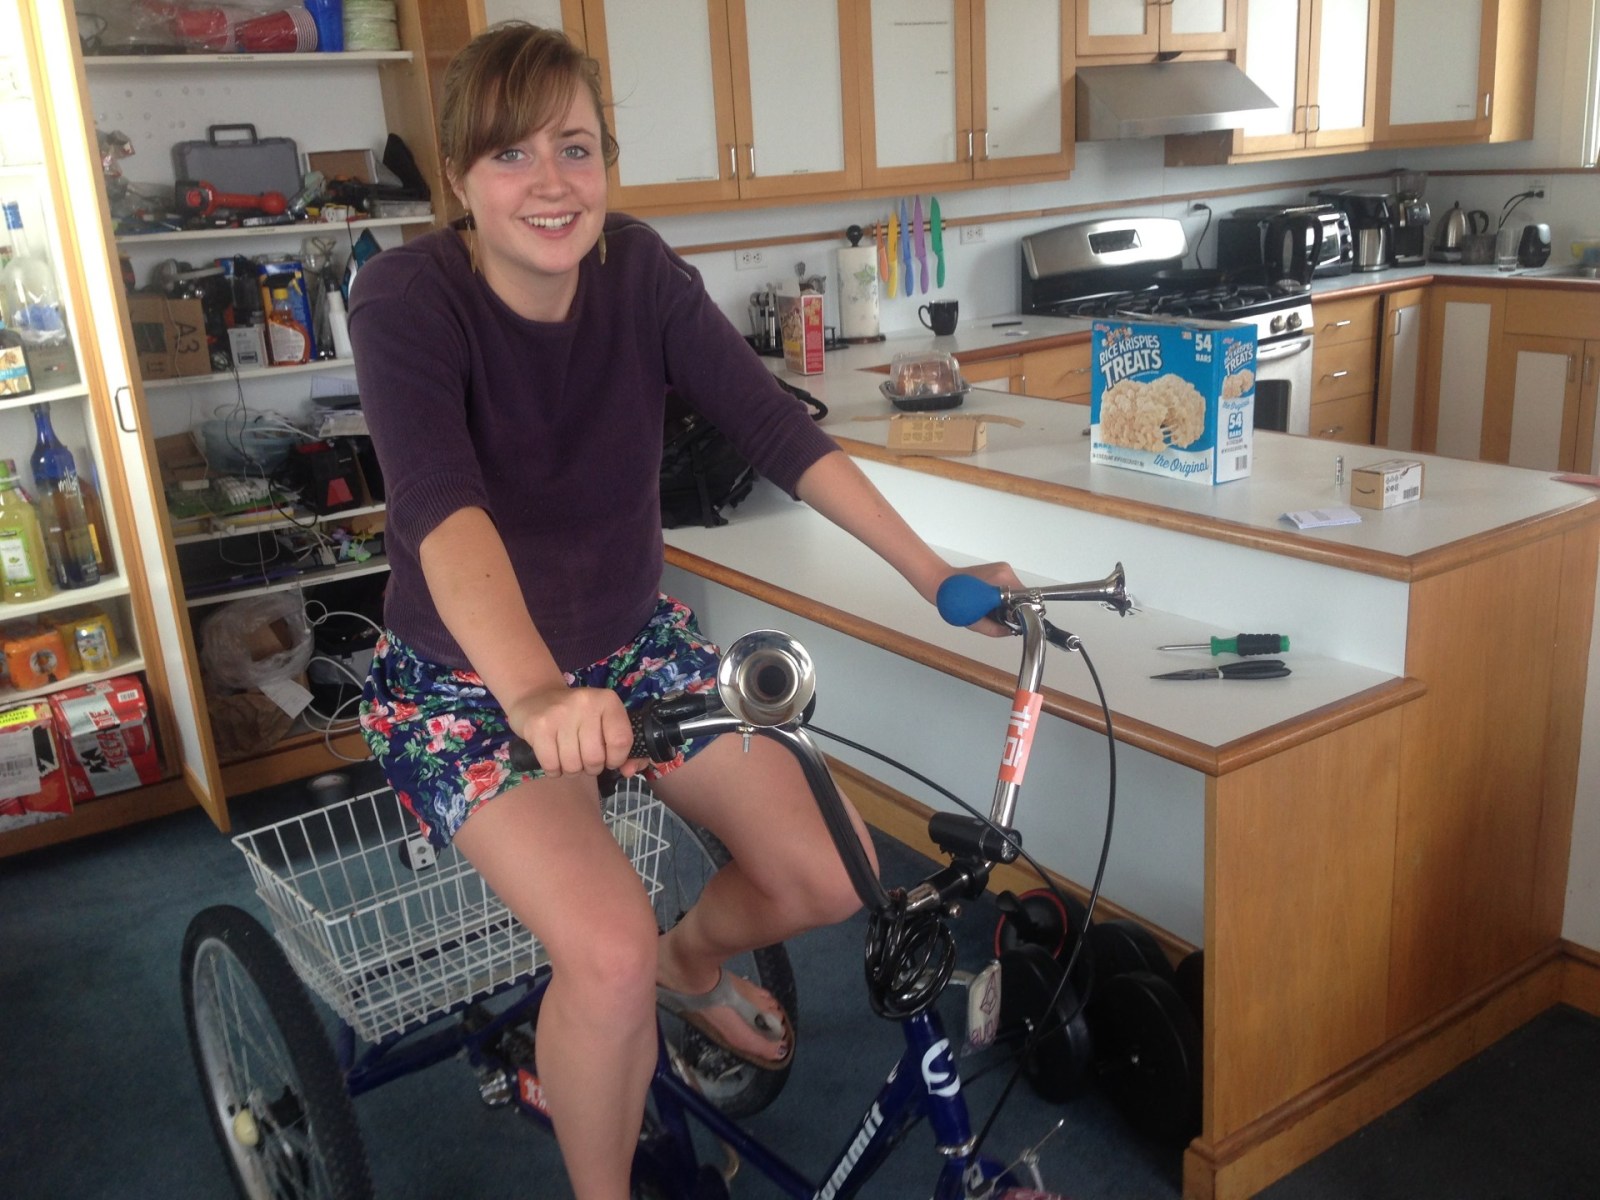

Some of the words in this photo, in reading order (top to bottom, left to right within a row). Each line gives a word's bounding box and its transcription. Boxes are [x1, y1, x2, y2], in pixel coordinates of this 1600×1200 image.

[1099, 343, 1119, 366] RICE
[1118, 335, 1160, 354] KRISPIES
[1195, 333, 1212, 352] 54
[1101, 349, 1163, 391] TREATS
[1225, 350, 1253, 377] TREATS
[1228, 411, 1243, 430] 54
[1154, 454, 1170, 468] the
[1170, 457, 1209, 478] Original
